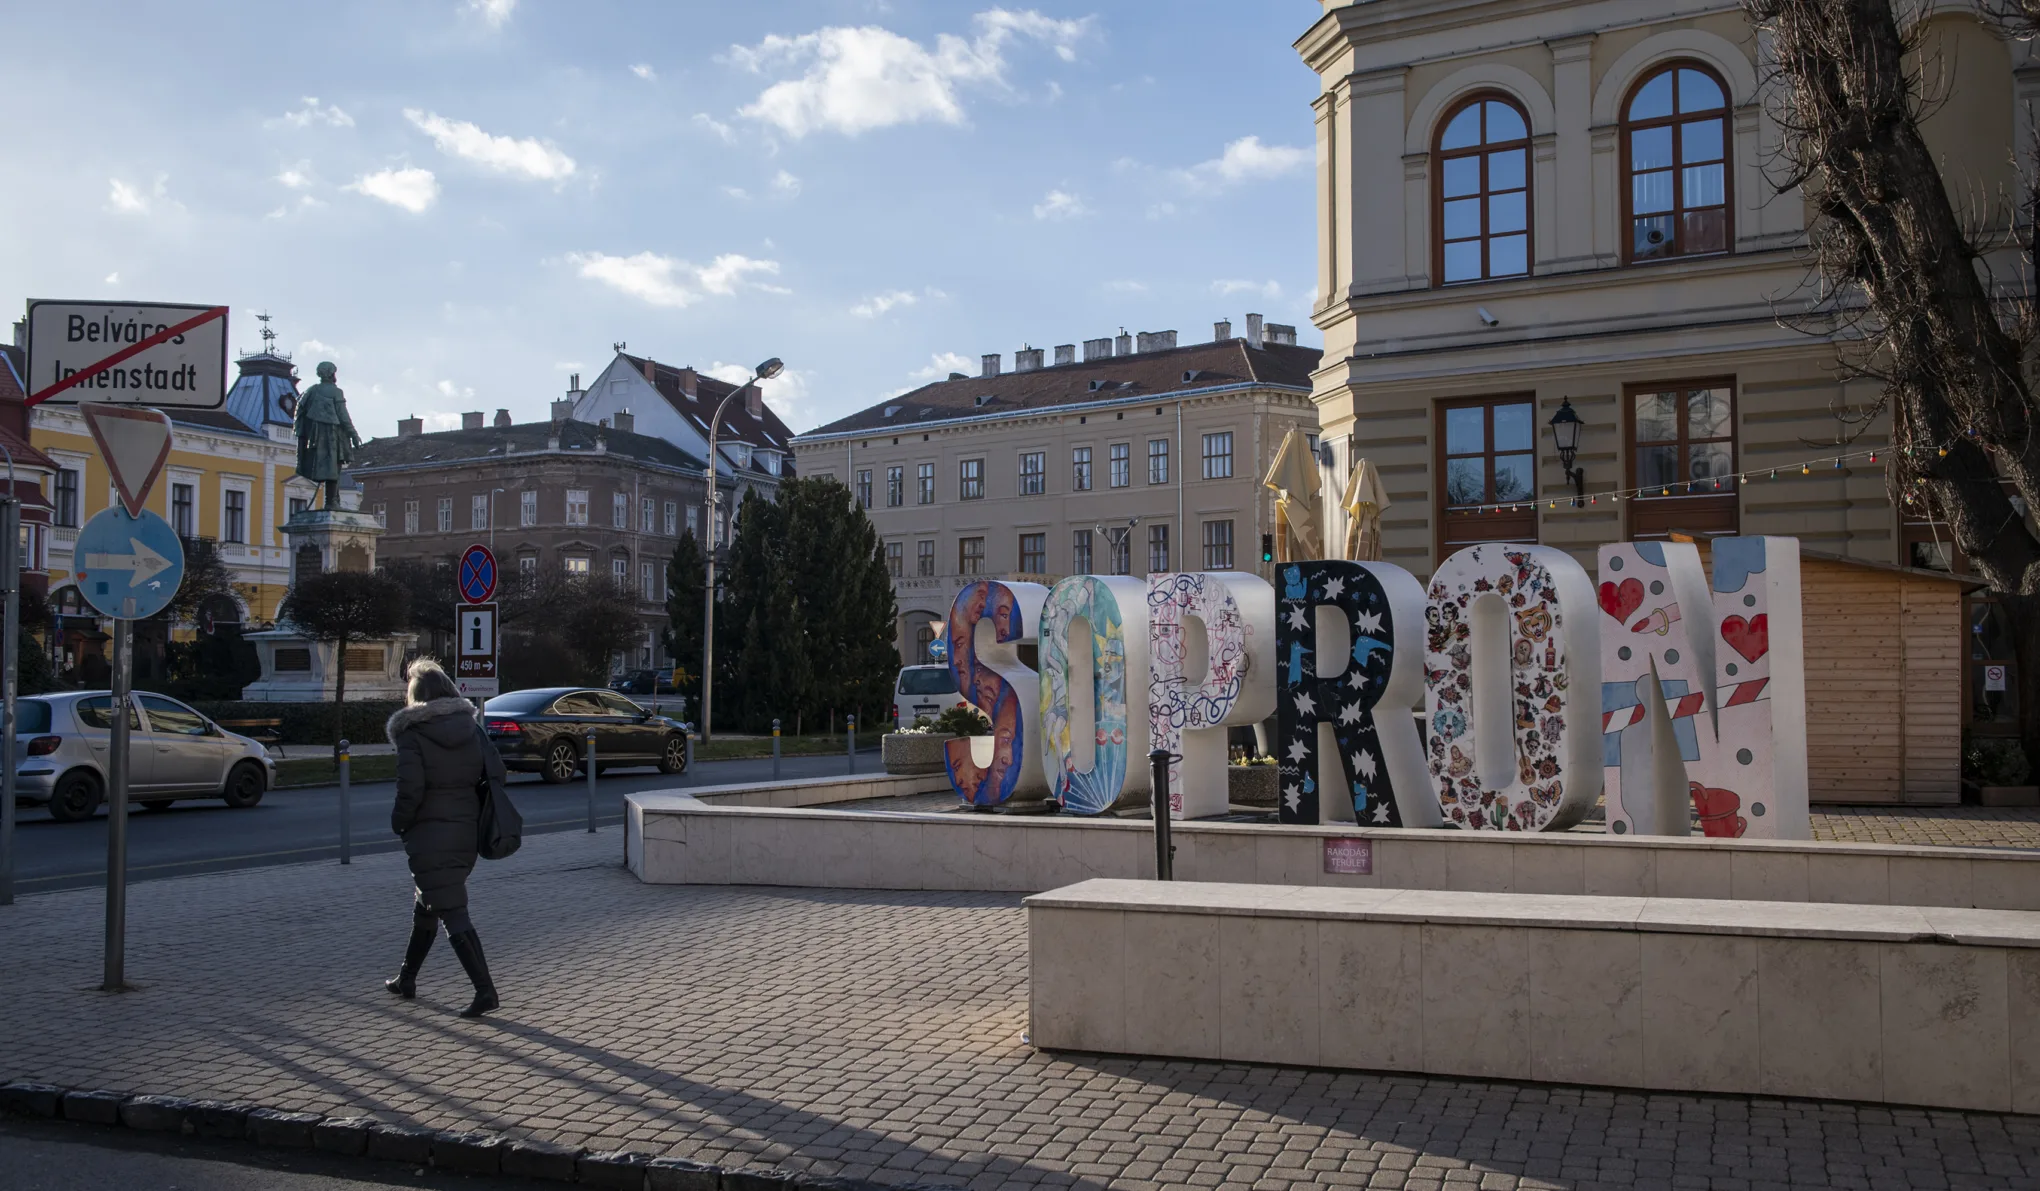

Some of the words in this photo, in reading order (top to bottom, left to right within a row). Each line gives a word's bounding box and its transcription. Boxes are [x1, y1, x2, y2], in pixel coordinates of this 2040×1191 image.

[460, 660, 473, 671] 450
[473, 661, 481, 670] m
[944, 536, 1809, 838] SOPRON
[1327, 847, 1369, 857] RAKODÁSI
